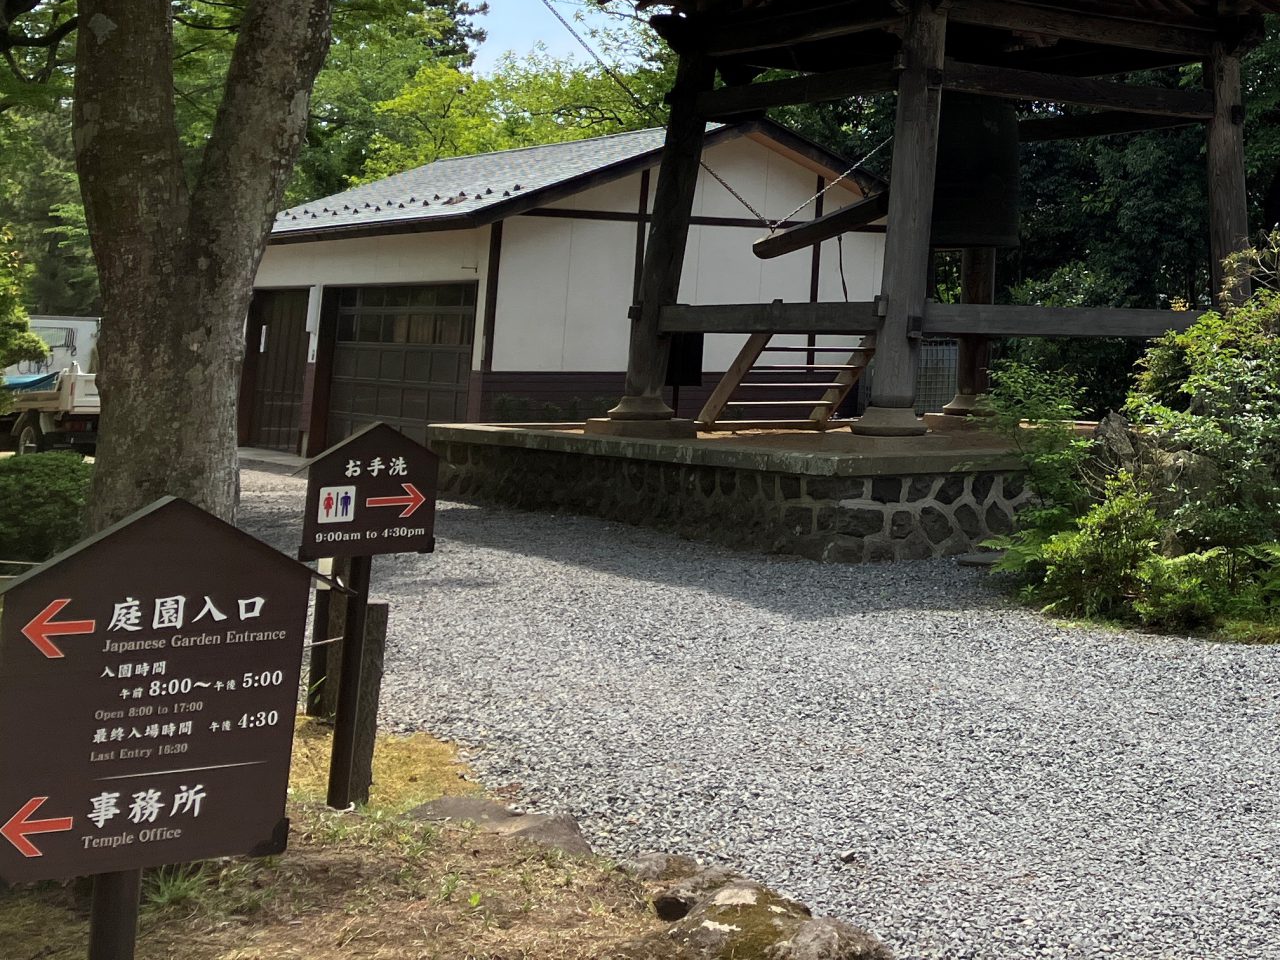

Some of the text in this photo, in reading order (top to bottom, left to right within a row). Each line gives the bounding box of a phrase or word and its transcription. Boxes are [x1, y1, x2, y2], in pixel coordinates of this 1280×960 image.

[344, 456, 408, 478] お手洗
[315, 526, 425, 543] 9:00am to 4:30pm
[106, 594, 266, 632] 庭園入口
[102, 628, 287, 654] Japanese Garden Entrance
[99, 660, 167, 679] 入園時間
[94, 701, 204, 721] Open 8:00 to 17:00
[90, 749, 115, 762] Last
[119, 746, 152, 760] Entry
[86, 783, 208, 829] 事務所
[81, 826, 182, 849] Temple Office
